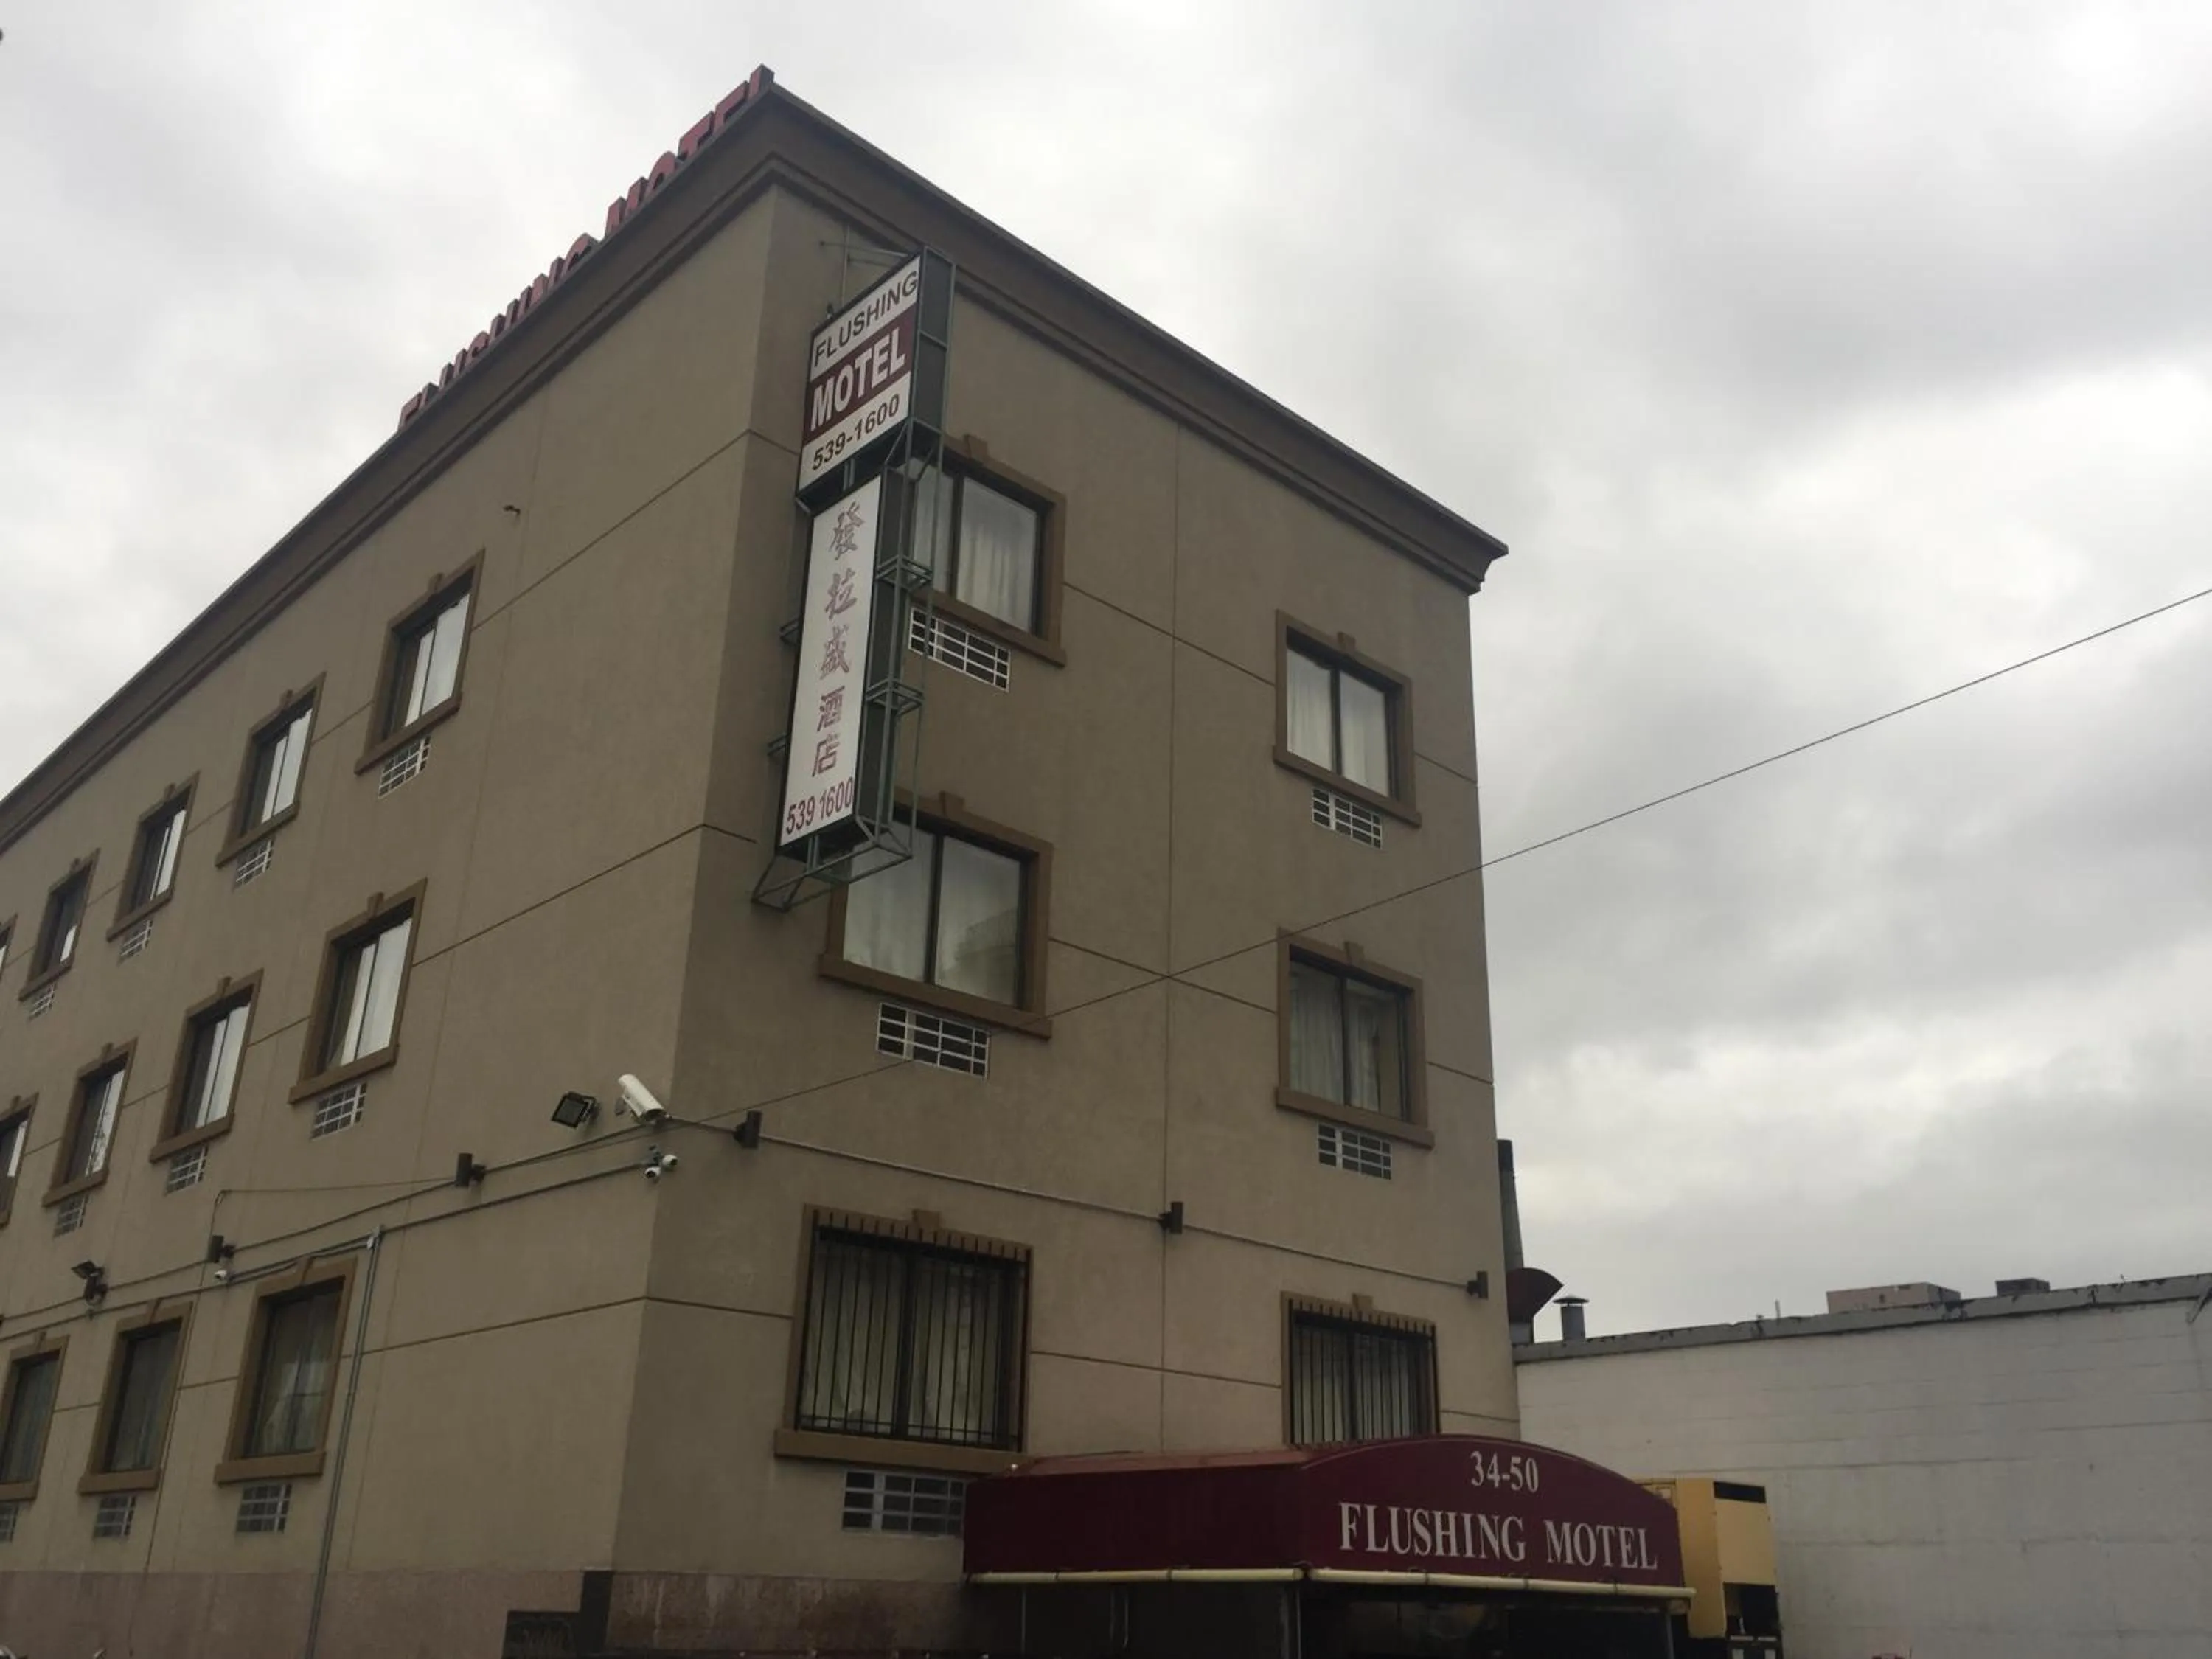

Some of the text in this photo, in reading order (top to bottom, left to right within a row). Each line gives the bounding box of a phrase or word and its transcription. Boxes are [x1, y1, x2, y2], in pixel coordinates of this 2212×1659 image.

[813, 271, 919, 368] FLUSHING
[810, 327, 906, 431] MOTEL
[811, 393, 900, 472] 539-1600
[1470, 1450, 1540, 1494] 34-50
[1338, 1501, 1658, 1571] FLUSHING MOTEL
